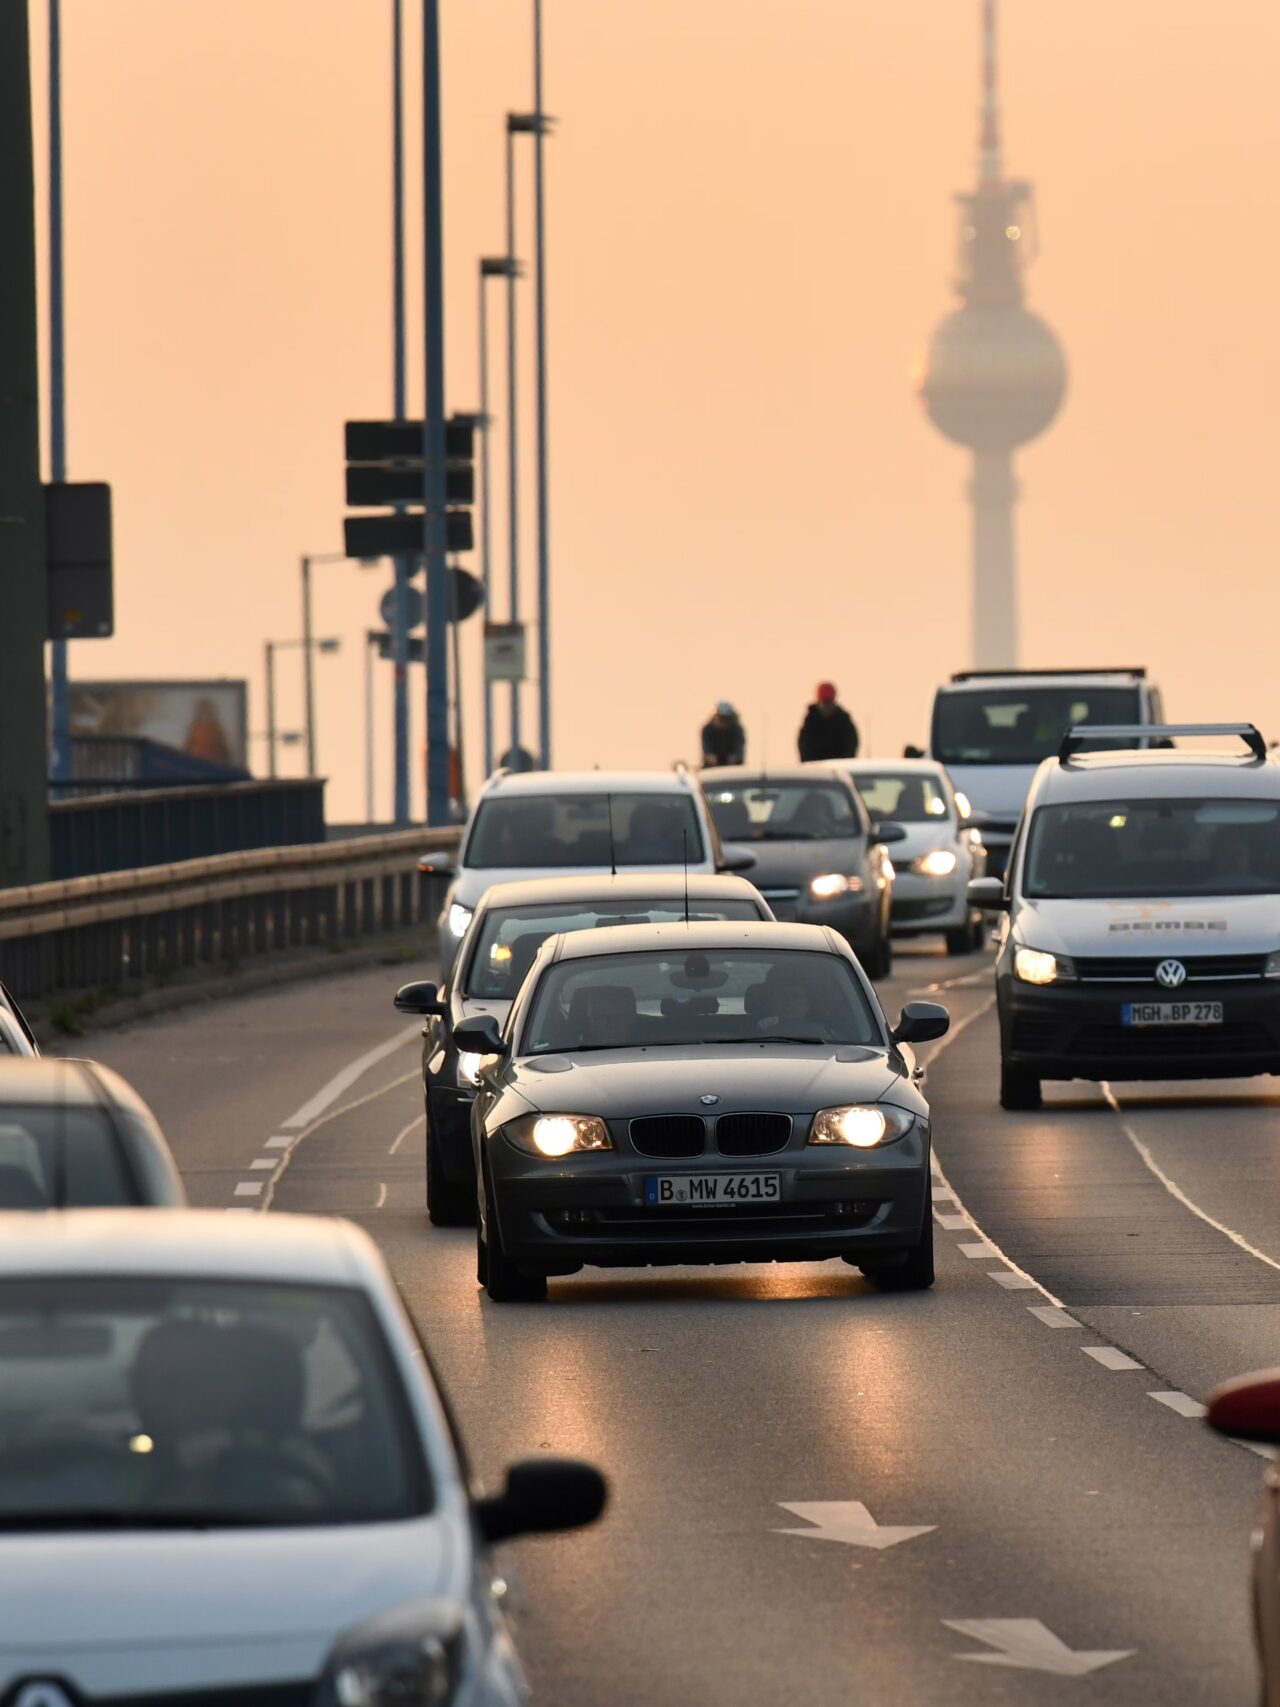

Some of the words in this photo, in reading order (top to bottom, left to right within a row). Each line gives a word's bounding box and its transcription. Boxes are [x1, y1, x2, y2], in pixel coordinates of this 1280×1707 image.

[1132, 1005, 1161, 1021] MGH
[1171, 1004, 1191, 1020] BP
[1194, 1003, 1222, 1020] 278
[660, 1179, 674, 1201] B
[689, 1178, 718, 1200] MW
[723, 1176, 778, 1198] 4615
